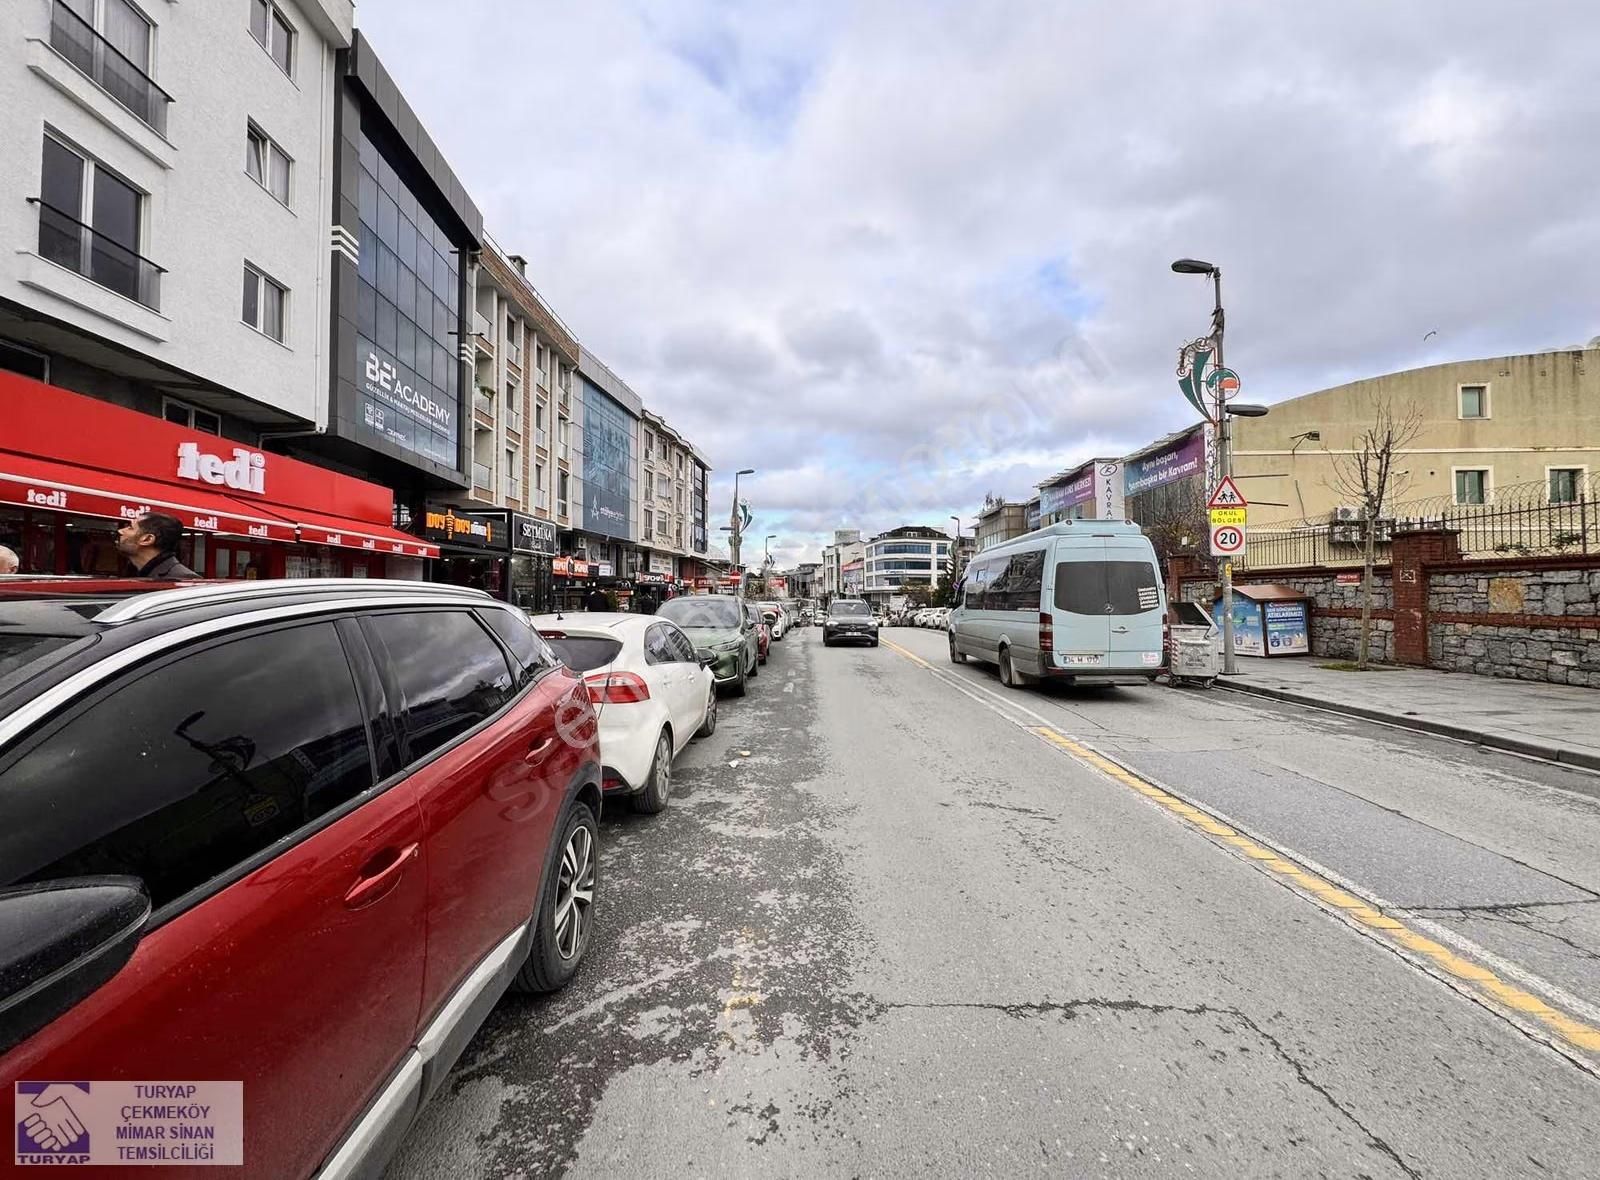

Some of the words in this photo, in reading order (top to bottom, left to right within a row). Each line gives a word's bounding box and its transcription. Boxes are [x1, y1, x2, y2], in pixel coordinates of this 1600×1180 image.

[394, 380, 450, 425] ACADEMY
[177, 442, 266, 495] tedi
[1168, 457, 1198, 478] Kavram!
[27, 489, 67, 508] tedi
[1105, 479, 1113, 519] KAVRA
[194, 516, 218, 529] tedi
[248, 525, 268, 536] tedi
[1220, 532, 1237, 544] 20
